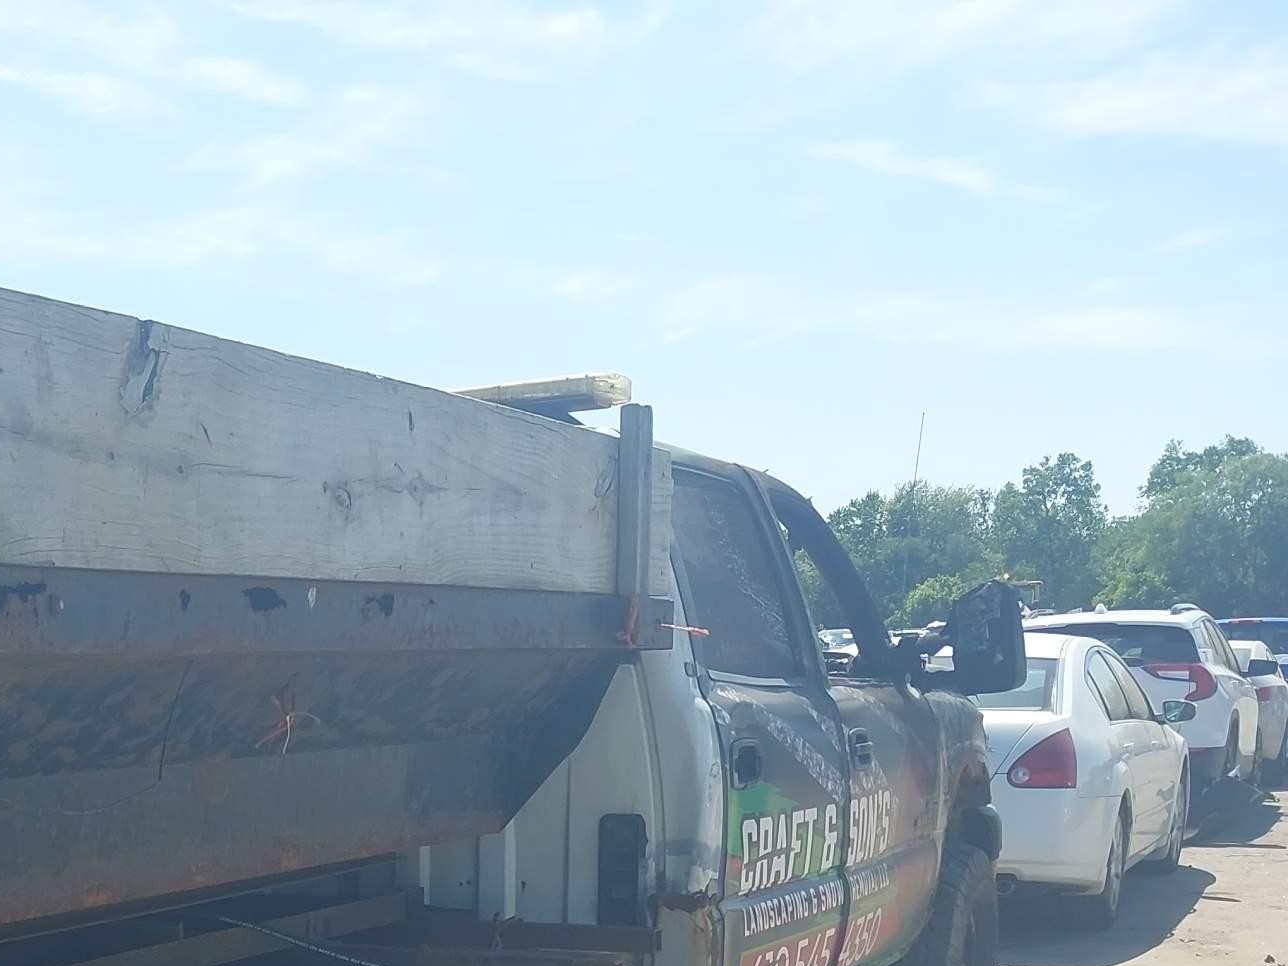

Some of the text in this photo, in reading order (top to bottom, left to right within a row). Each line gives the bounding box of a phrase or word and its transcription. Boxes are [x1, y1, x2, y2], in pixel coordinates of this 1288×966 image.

[738, 789, 890, 895] CRAFT & SON'S
[743, 890, 809, 936] LANDSCAPING
[810, 888, 818, 914] &
[818, 879, 844, 911] SNOW
